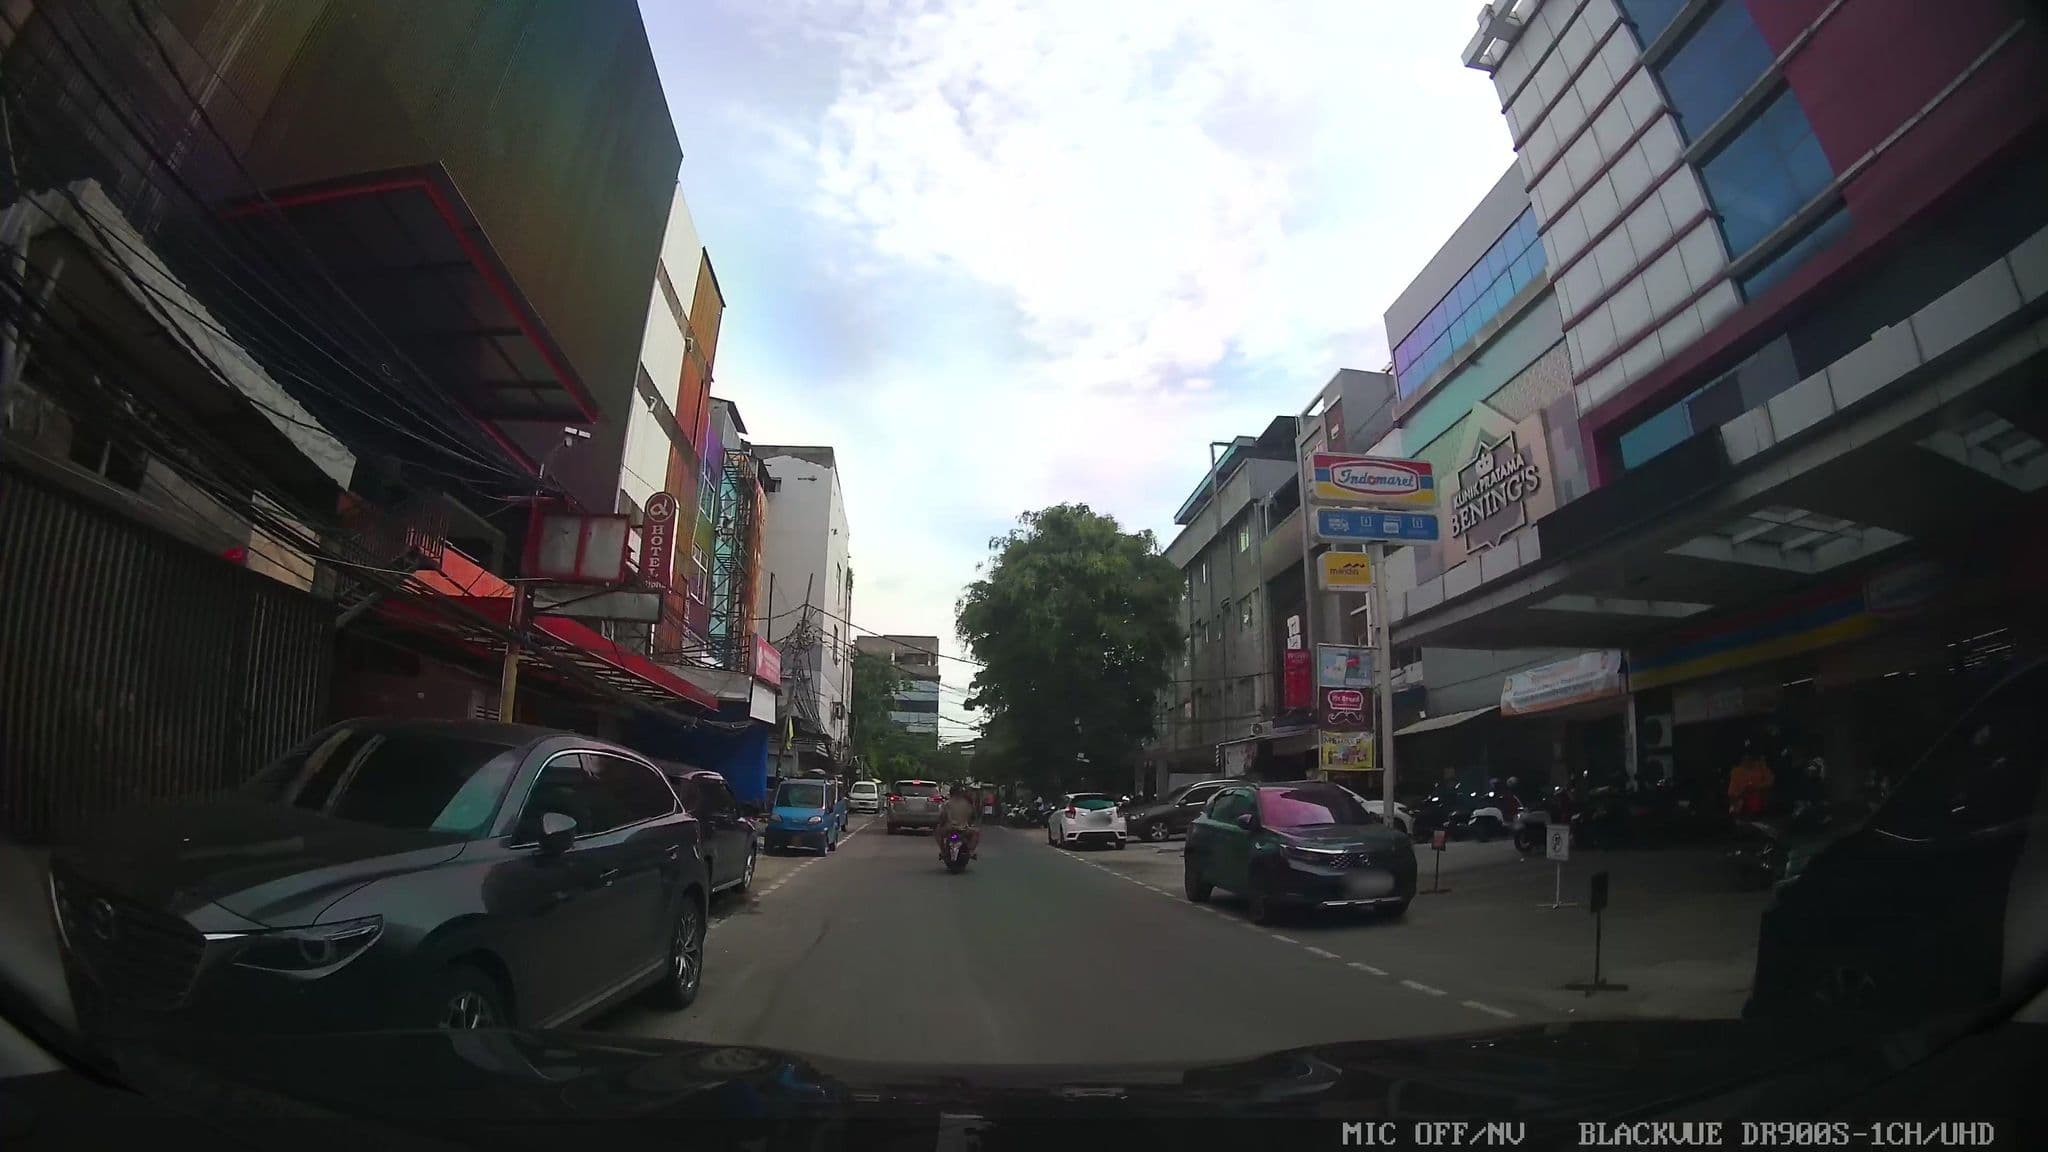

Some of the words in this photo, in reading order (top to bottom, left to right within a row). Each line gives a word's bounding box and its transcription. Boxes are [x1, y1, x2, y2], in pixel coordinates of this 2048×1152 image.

[1338, 469, 1414, 487] Indomaret
[1450, 466, 1539, 537] BENING'S
[1454, 482, 1480, 509] KLINIK
[1479, 453, 1525, 490] PRATAMA
[648, 525, 664, 577] HOTEL
